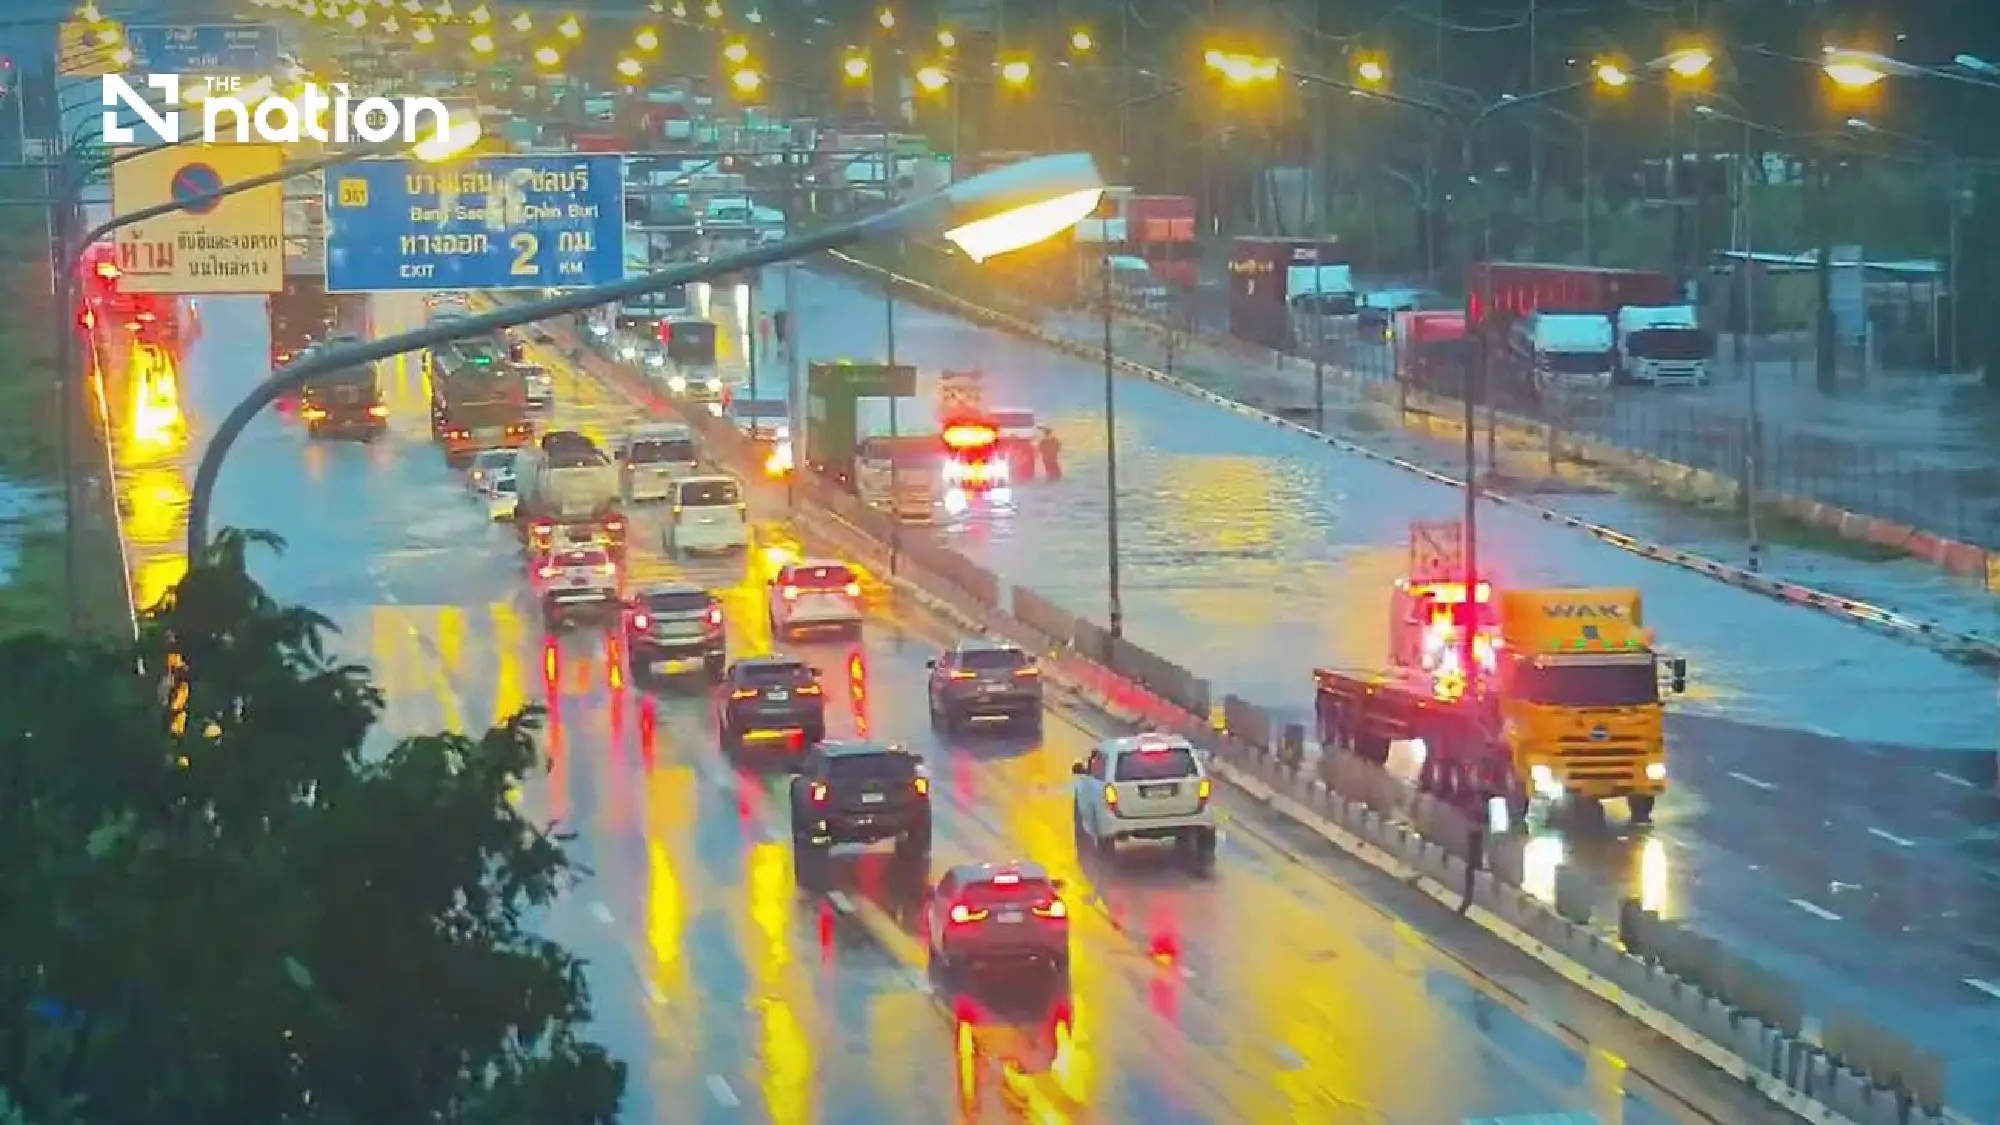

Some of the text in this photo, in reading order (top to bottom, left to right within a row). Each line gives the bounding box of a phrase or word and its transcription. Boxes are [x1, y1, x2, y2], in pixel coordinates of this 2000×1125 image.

[532, 163, 589, 200] ชลบุรี
[119, 229, 175, 269] ห้าม
[400, 233, 488, 256] ทางออก
[509, 231, 540, 276] 2
[400, 261, 584, 279] EXIT KM
